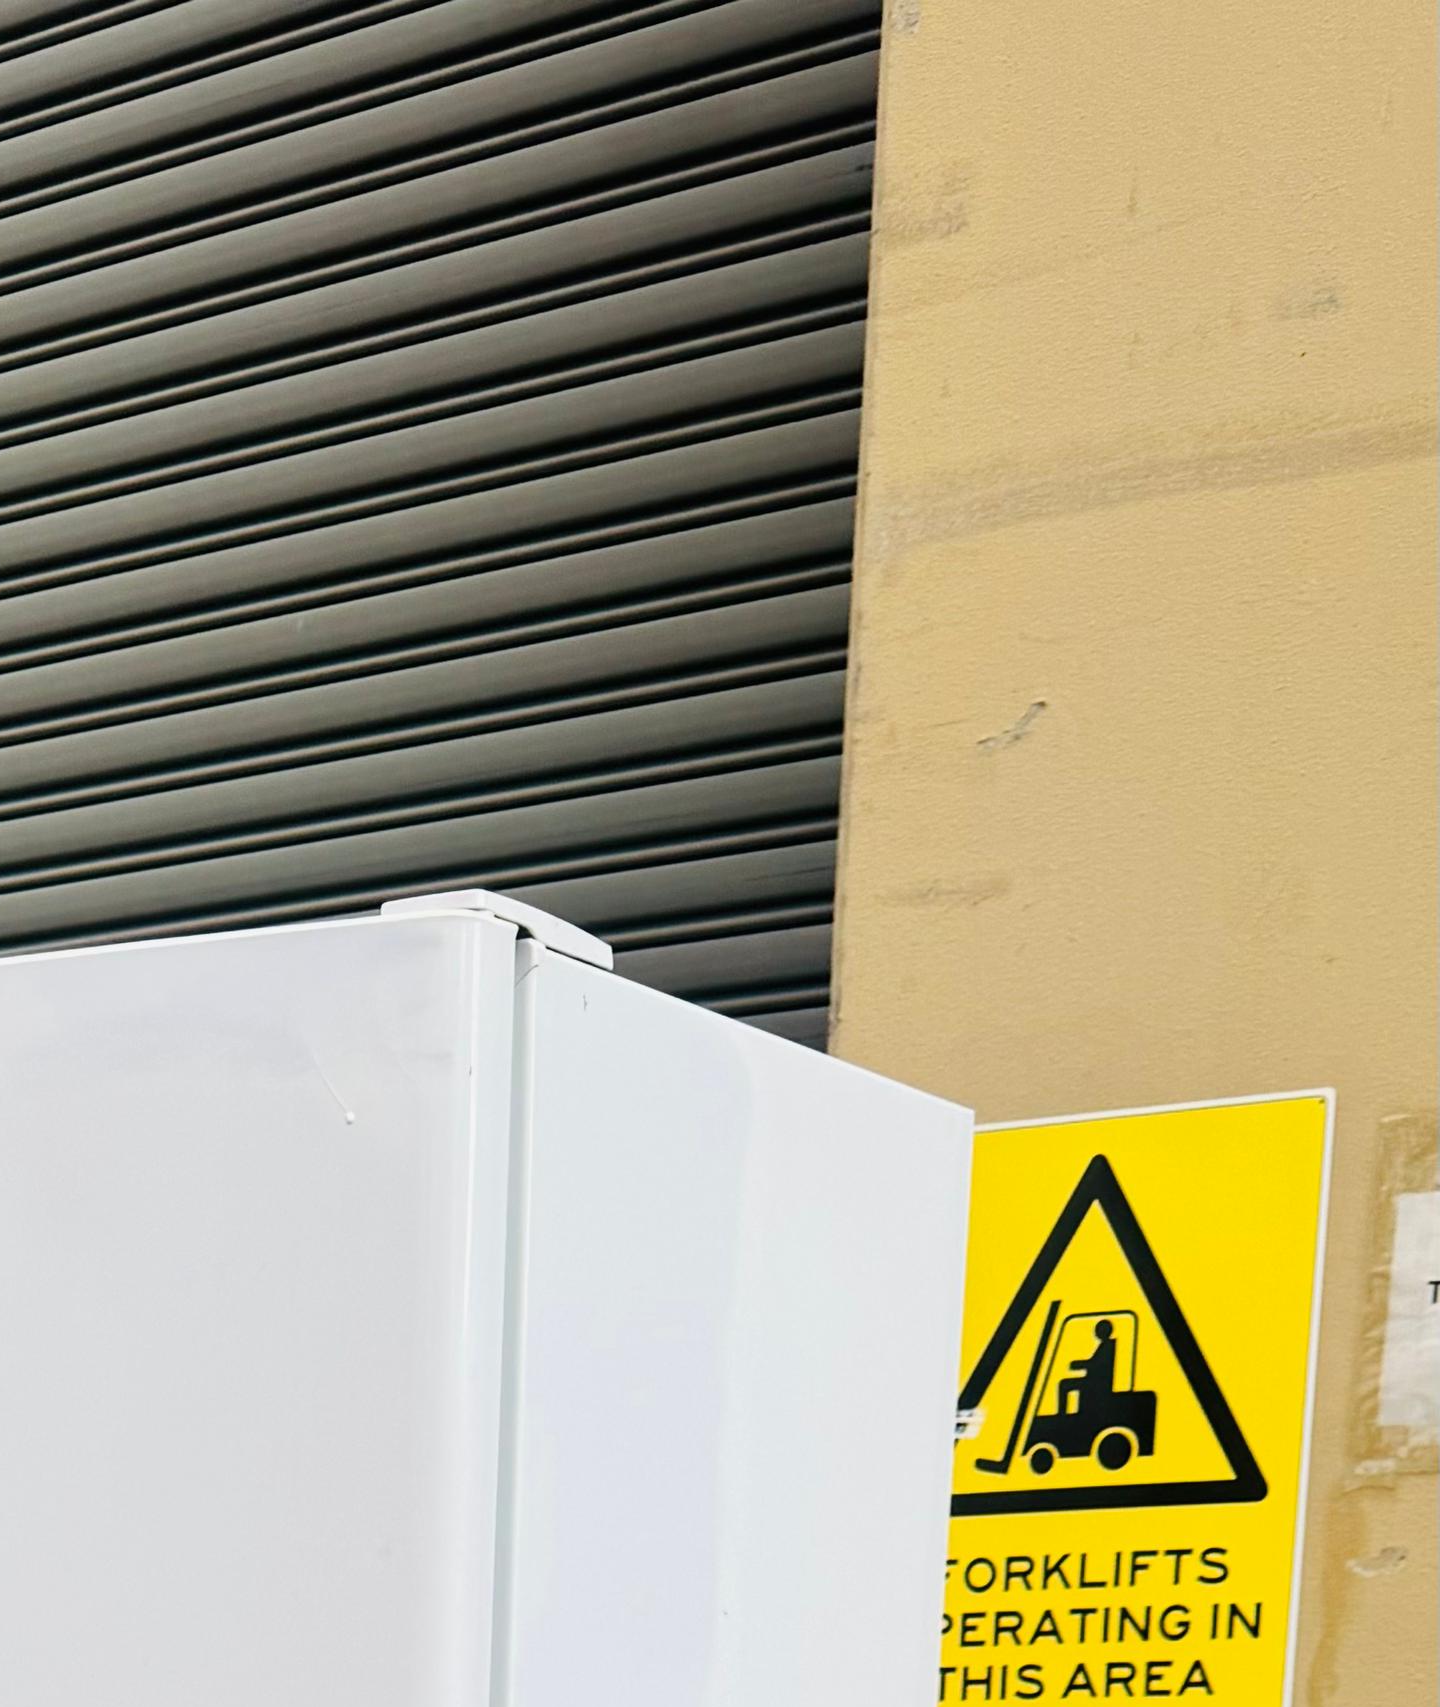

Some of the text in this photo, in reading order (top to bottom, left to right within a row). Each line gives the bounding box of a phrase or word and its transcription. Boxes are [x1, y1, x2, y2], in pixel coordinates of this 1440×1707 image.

[942, 1603, 1261, 1647] ERATING IN
[940, 1660, 1212, 1701] THIS AREA
